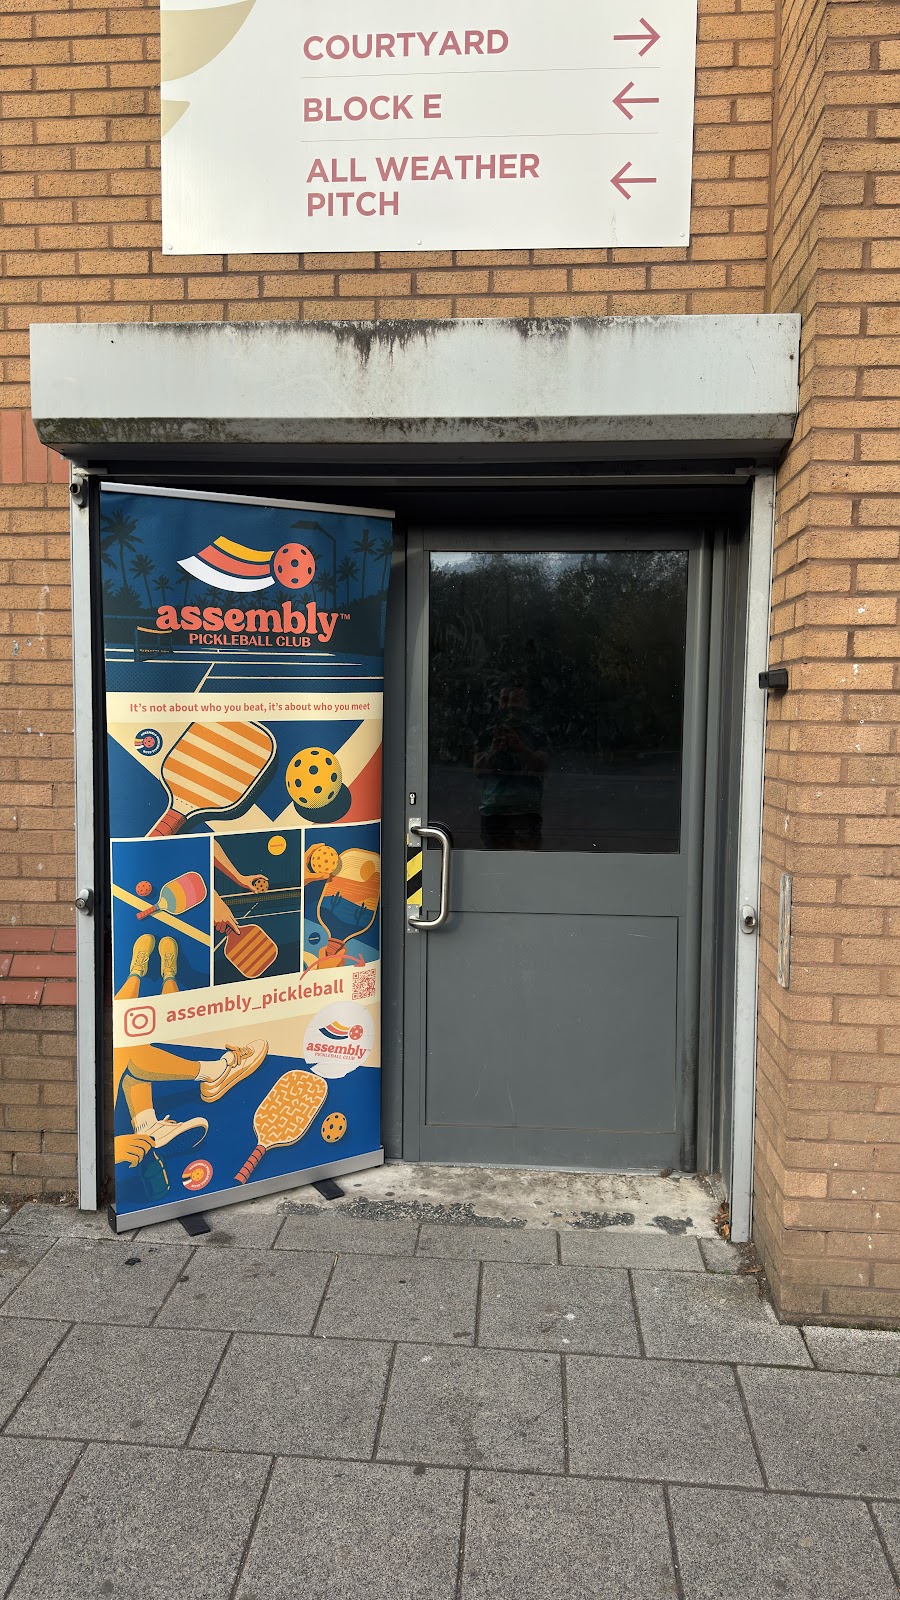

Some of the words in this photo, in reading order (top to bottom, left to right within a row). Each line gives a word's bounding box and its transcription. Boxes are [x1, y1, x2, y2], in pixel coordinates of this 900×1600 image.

[303, 29, 509, 61] COURTYARD
[303, 94, 414, 122] BLOCK
[423, 93, 442, 119] E
[306, 157, 367, 183] ALL
[375, 153, 540, 182] WEATHER
[307, 191, 399, 217] PITCH
[189, 633, 273, 647] PICKLEBALL
[275, 635, 311, 648] CLUB
[149, 703, 167, 712] not
[169, 703, 198, 712] about
[200, 702, 221, 712] who
[224, 704, 241, 713] you
[243, 702, 267, 713] beat,
[284, 702, 311, 711] about
[313, 702, 333, 711] who
[334, 703, 350, 713] you
[351, 702, 370, 711] meet
[166, 979, 344, 1023] assembly_pickleball
[306, 1042, 366, 1060] assembly
